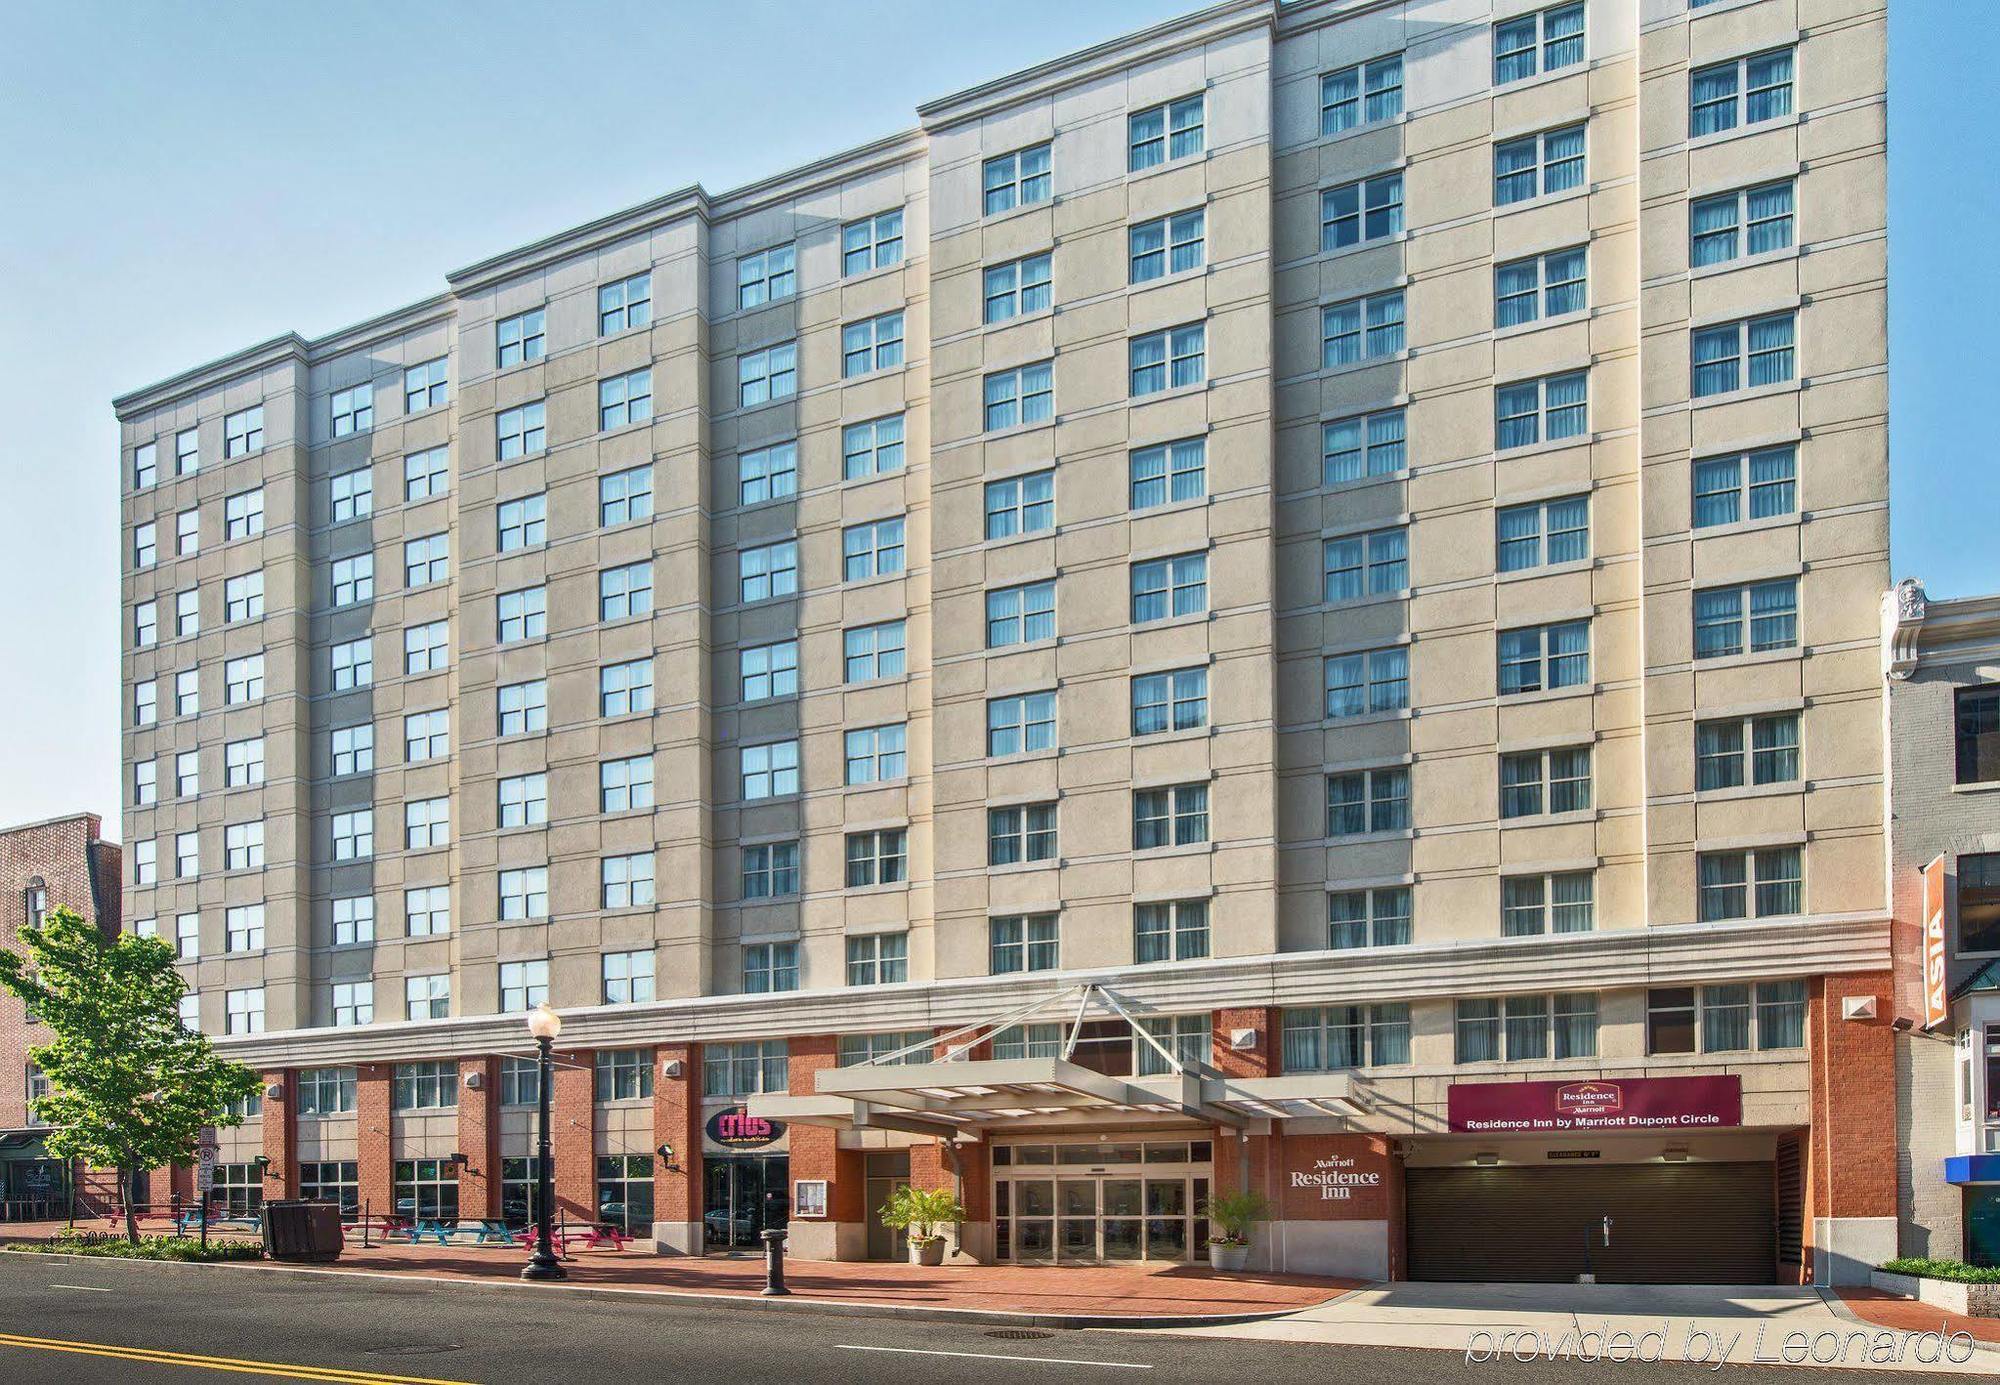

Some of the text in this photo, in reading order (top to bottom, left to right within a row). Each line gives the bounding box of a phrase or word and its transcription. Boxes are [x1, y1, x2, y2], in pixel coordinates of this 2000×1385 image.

[1929, 907, 1945, 1011] ASIA
[1563, 1093, 1615, 1101] Residence
[1572, 1106, 1605, 1114] Marriott
[1466, 1114, 1720, 1129] Residence Inn by Marriott Dupont Circle
[1313, 1158, 1354, 1168] Marriott
[1290, 1171, 1379, 1187] Residence
[1320, 1185, 1351, 1200] Inn
